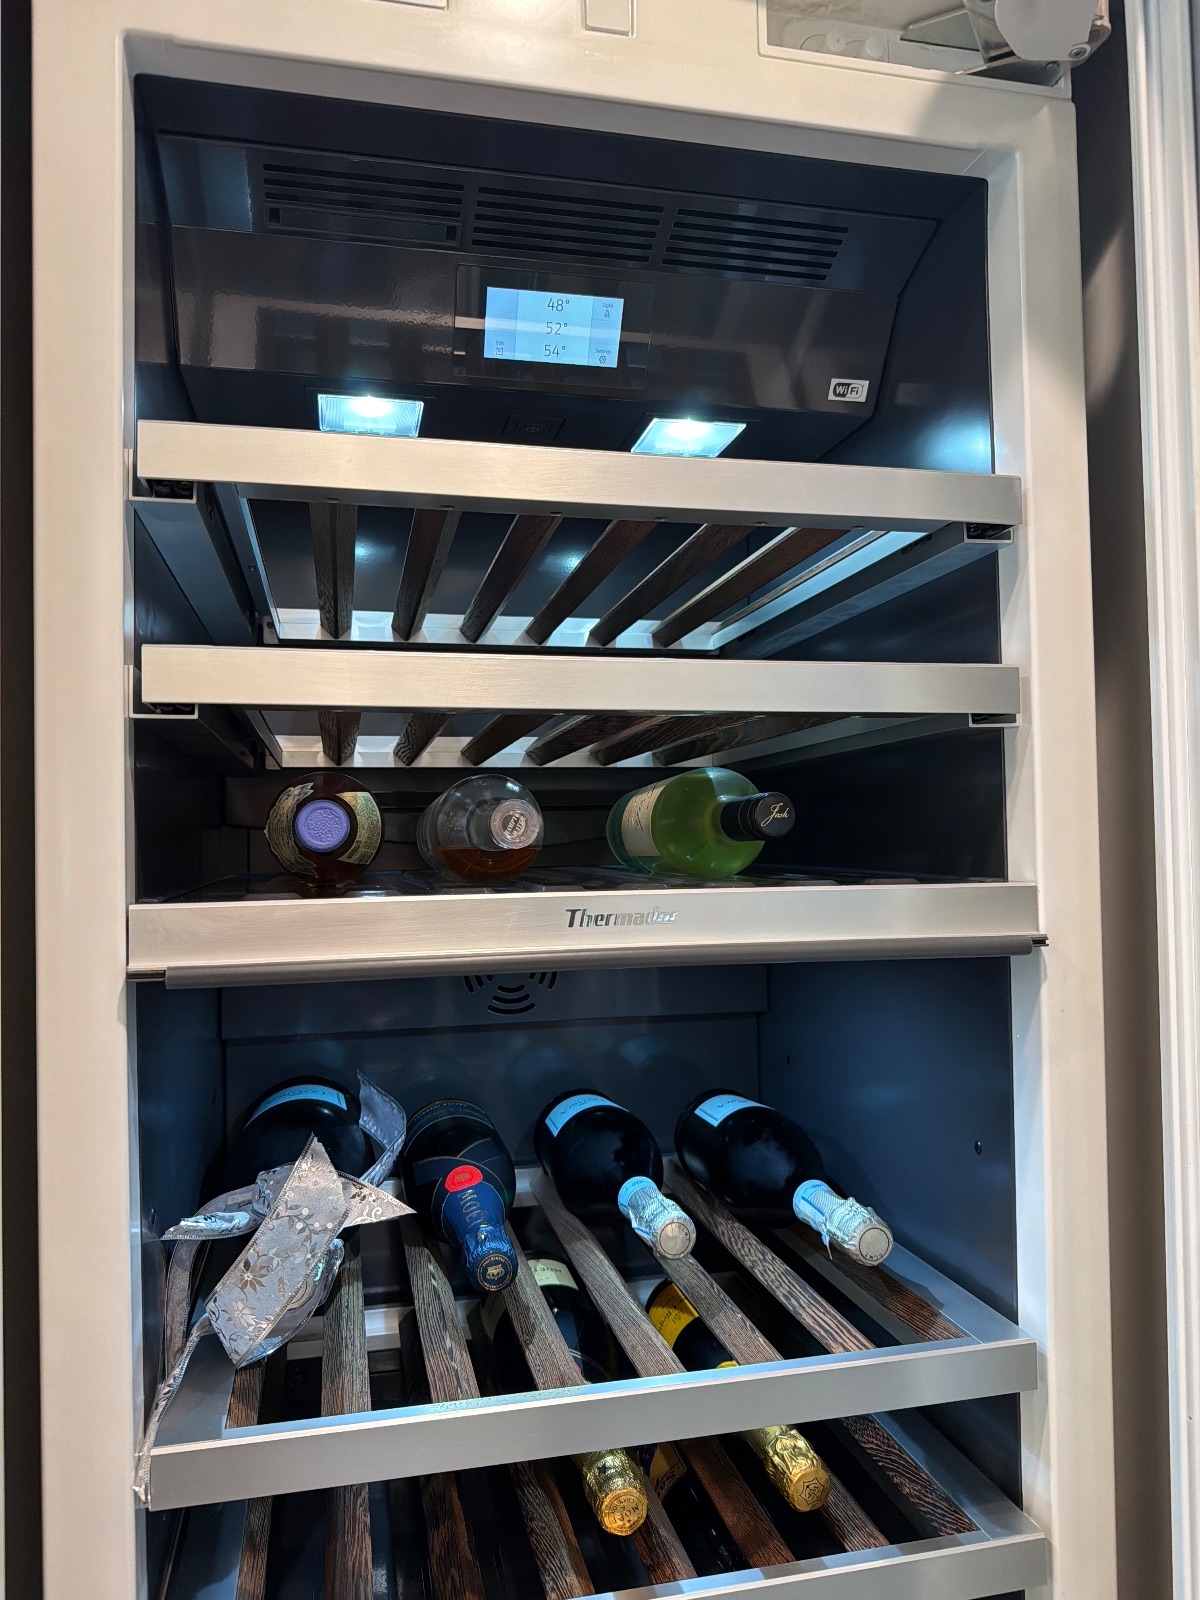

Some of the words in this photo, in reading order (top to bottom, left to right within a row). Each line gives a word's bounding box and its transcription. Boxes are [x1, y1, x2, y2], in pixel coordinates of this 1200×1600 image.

[547, 298, 570, 312] 48°
[546, 321, 568, 335] 52°
[544, 344, 566, 358] 54°
[595, 347, 612, 355] Settings
[761, 802, 790, 827] Josh
